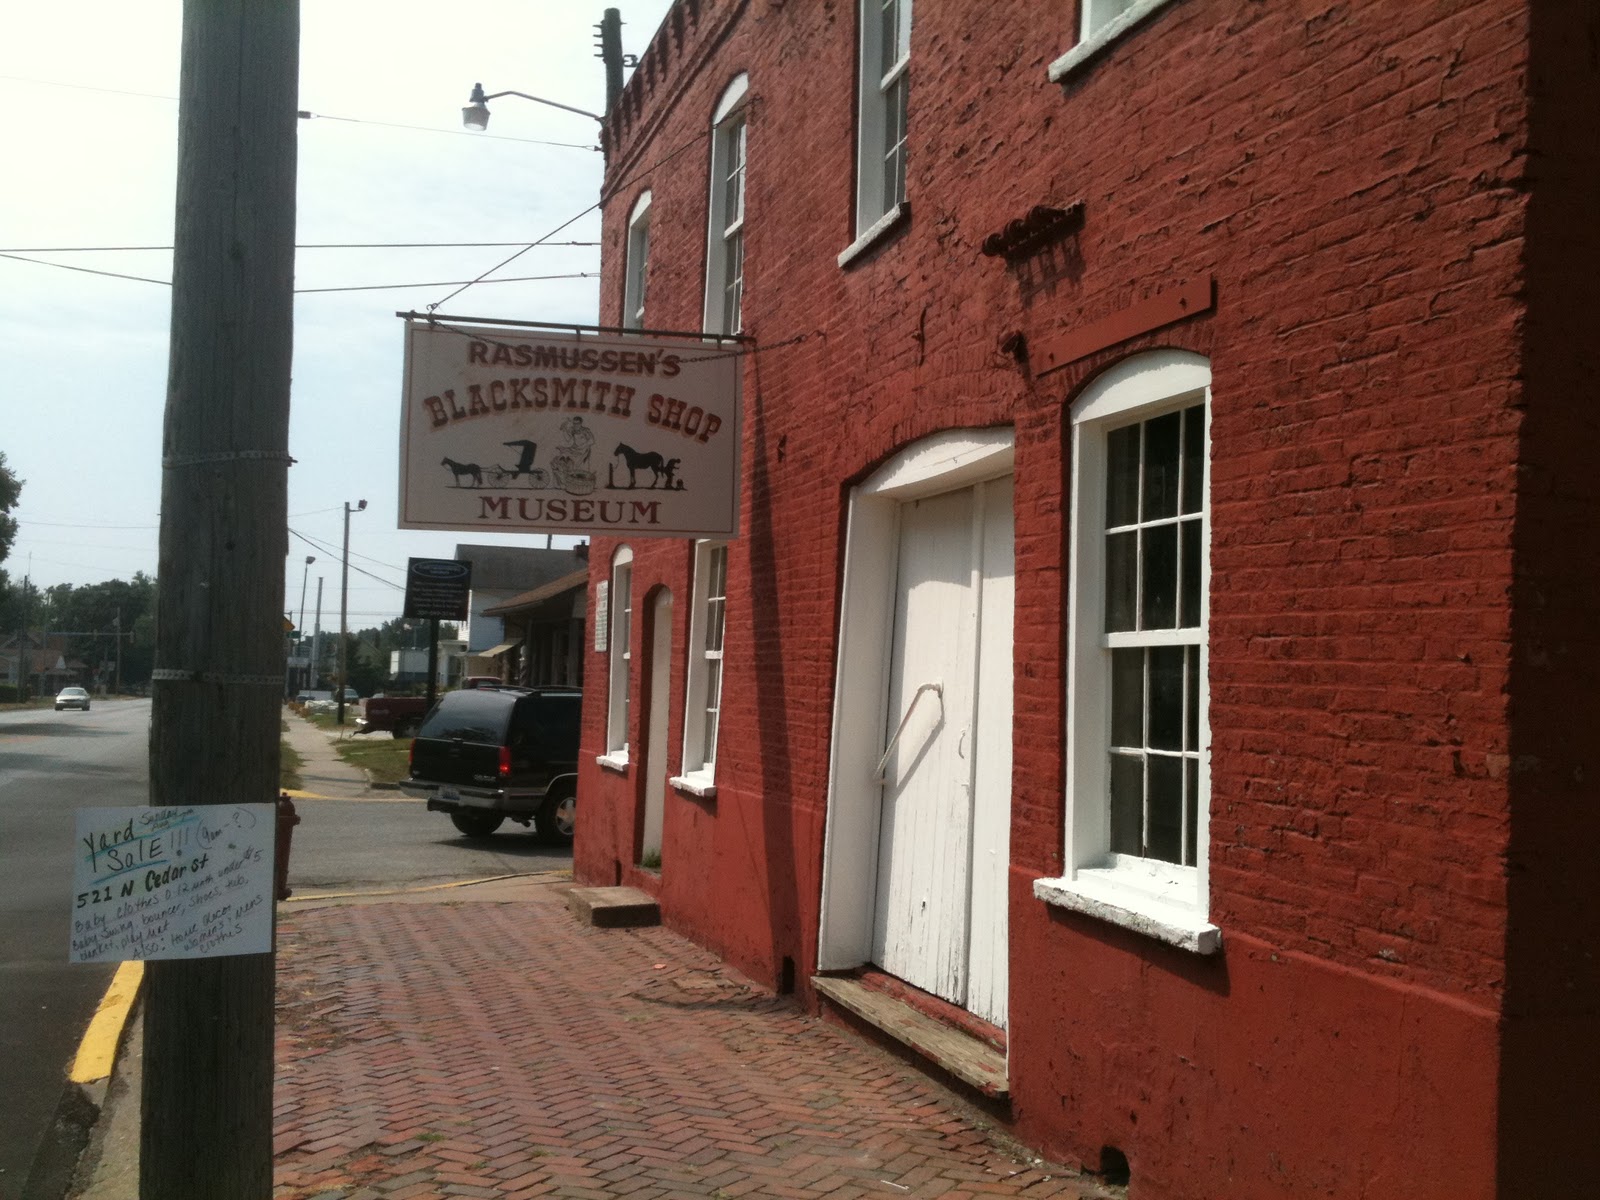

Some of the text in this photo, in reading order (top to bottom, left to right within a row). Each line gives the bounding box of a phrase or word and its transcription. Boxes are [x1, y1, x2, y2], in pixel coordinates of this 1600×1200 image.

[467, 340, 681, 378] RASMUSSEN'S
[424, 377, 722, 443] BLACKSMITH SHOP
[477, 495, 661, 524] MUSEUM
[83, 817, 134, 873] Yard
[77, 886, 112, 909] 521
[120, 880, 134, 897] N
[145, 864, 187, 892] Cedar
